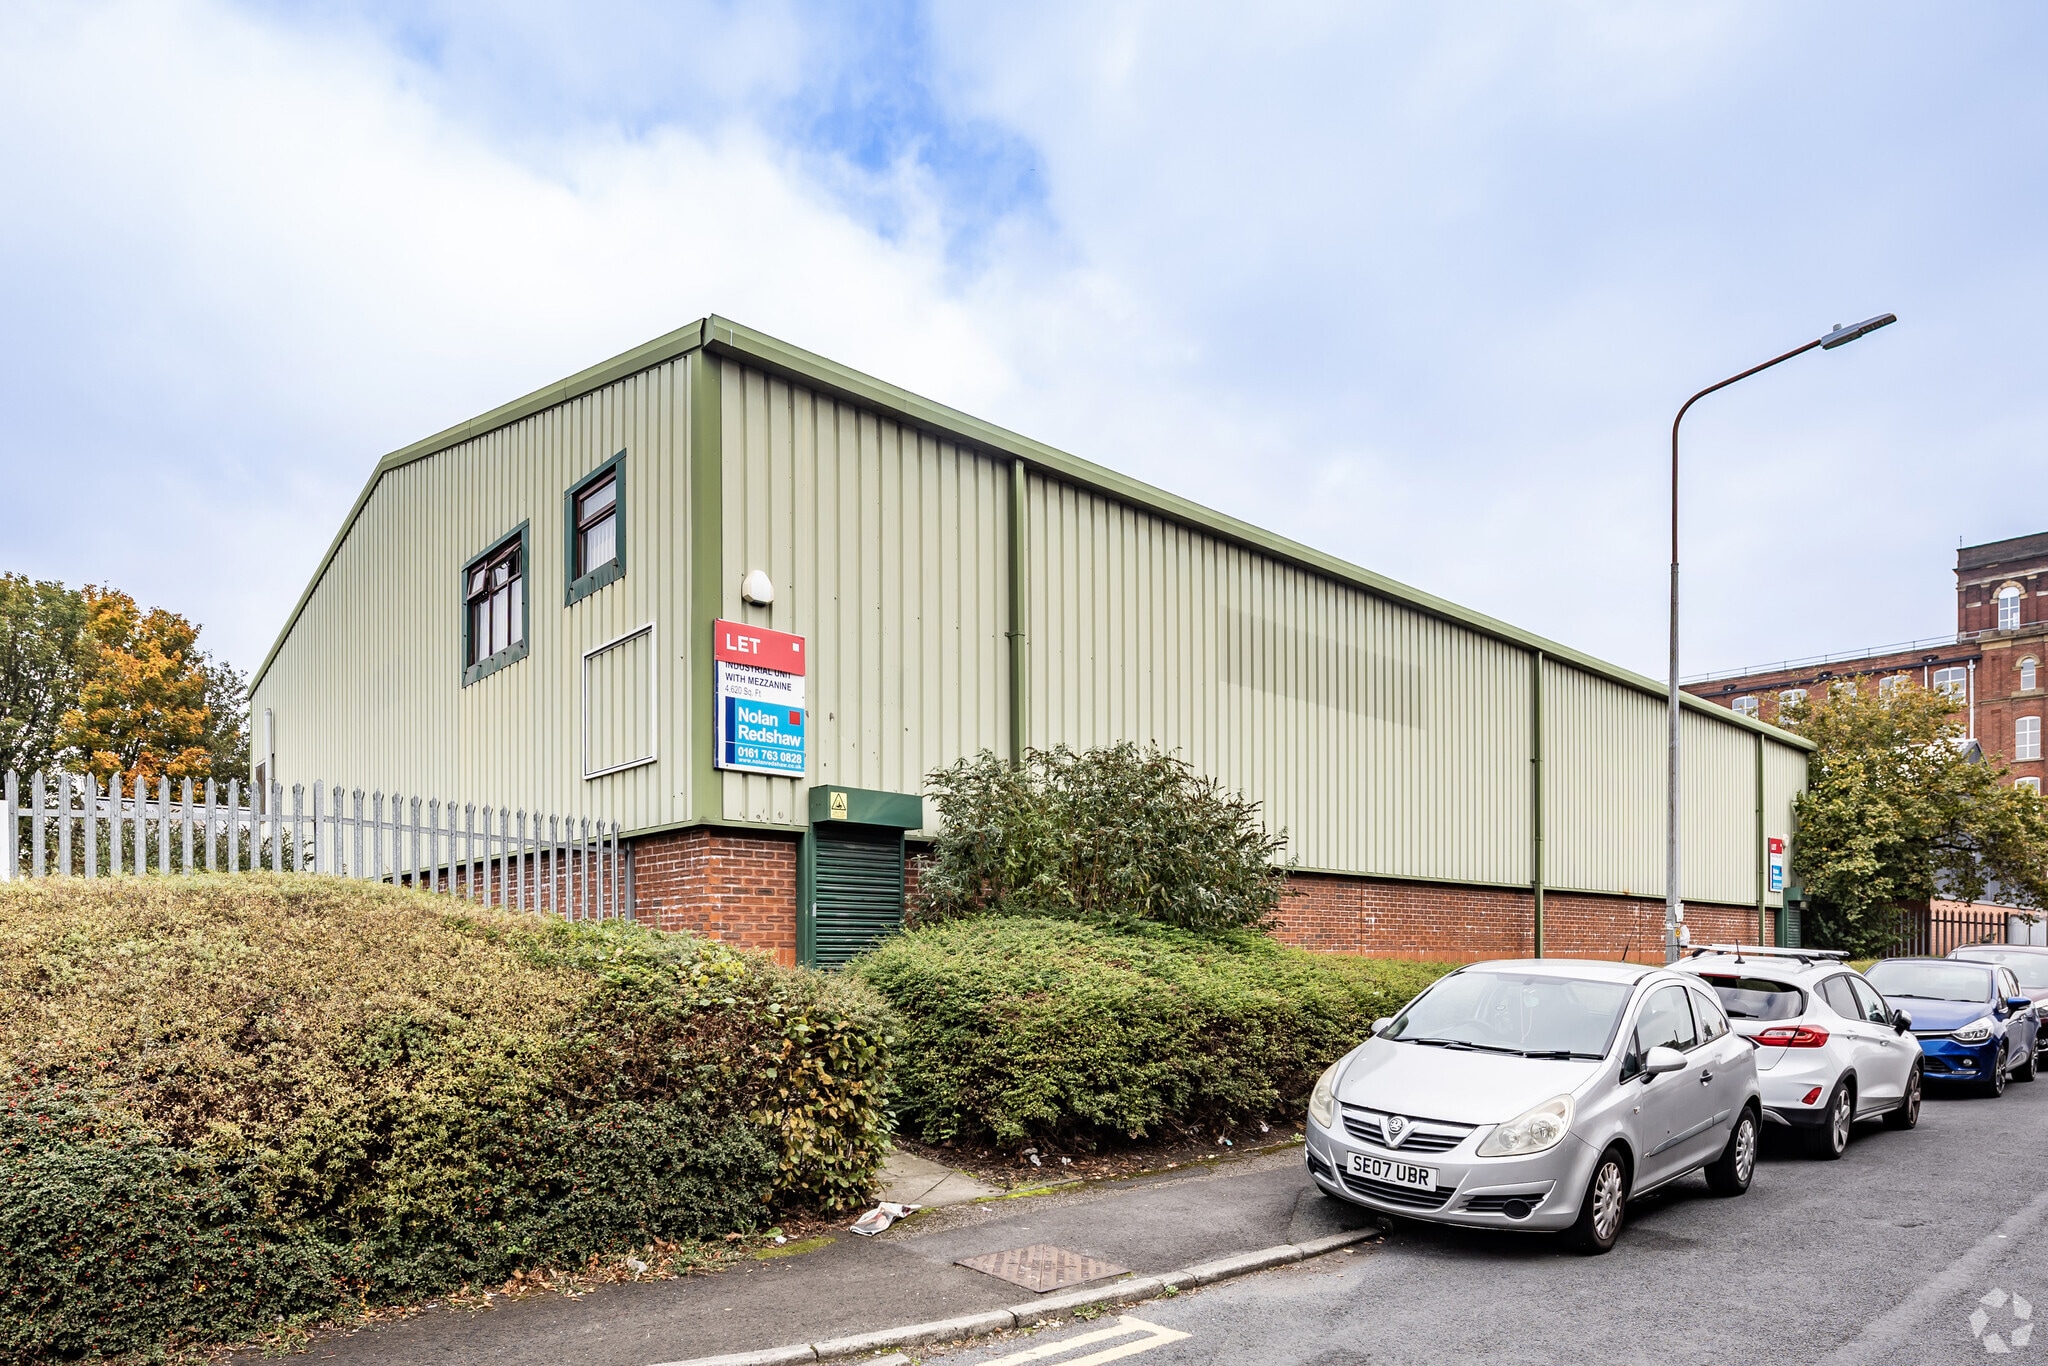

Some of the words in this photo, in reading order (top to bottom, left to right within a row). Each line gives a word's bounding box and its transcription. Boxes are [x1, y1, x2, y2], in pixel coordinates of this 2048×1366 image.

[726, 633, 760, 654] LET
[725, 661, 772, 676] INDUSTRIAL
[725, 672, 746, 683] WITH
[748, 676, 792, 692] MEZZANINE
[738, 706, 778, 727] Nolan
[738, 725, 801, 747] Redshaw
[738, 746, 759, 759] 0161
[761, 749, 778, 761] 763
[780, 752, 802, 764] 0828
[738, 758, 802, 769] www.nolanredshaw.co.uk
[1353, 1155, 1392, 1178] SE07
[1396, 1164, 1429, 1186] UBR
